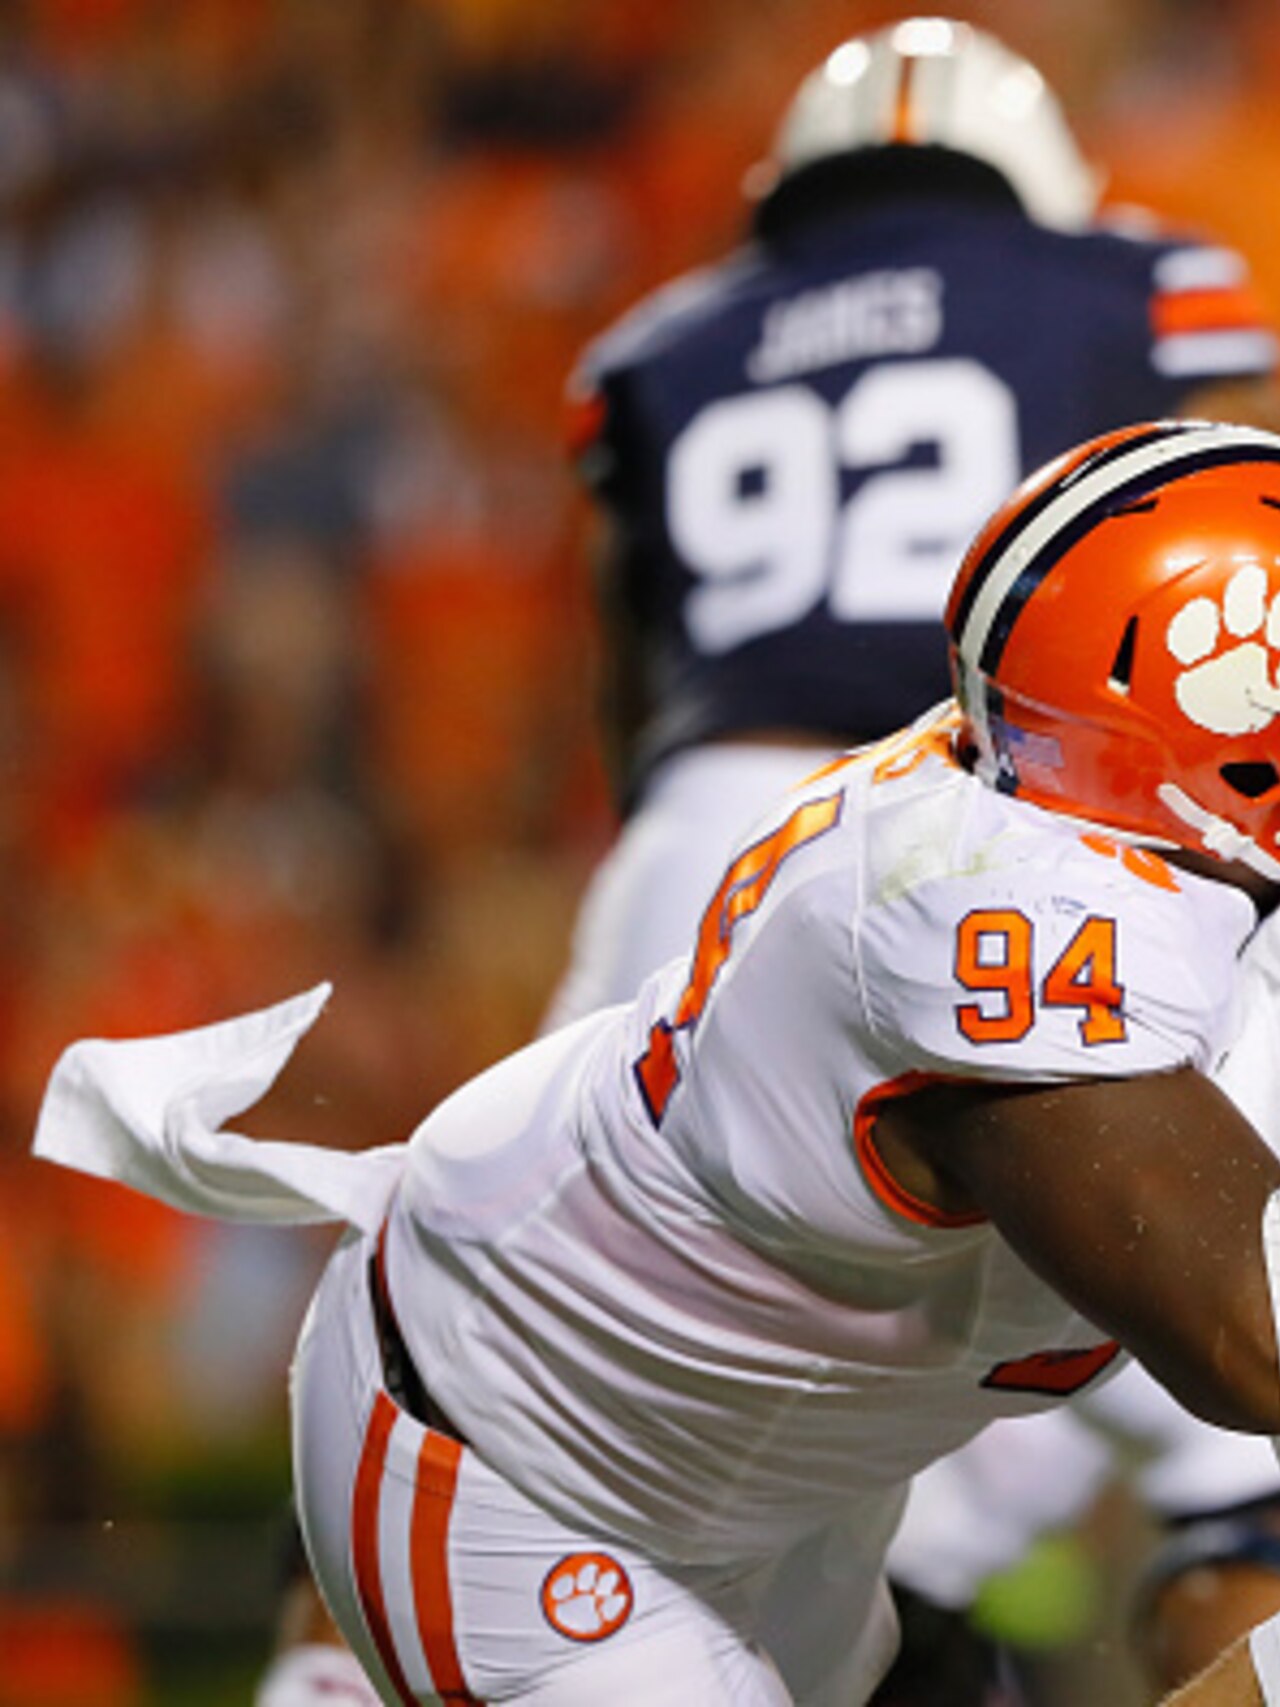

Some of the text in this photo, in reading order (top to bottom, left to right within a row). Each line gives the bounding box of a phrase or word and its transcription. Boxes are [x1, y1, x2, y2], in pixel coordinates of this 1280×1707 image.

[747, 266, 944, 383] JAMES
[665, 356, 1019, 655] 92
[951, 907, 1129, 1047] 94
